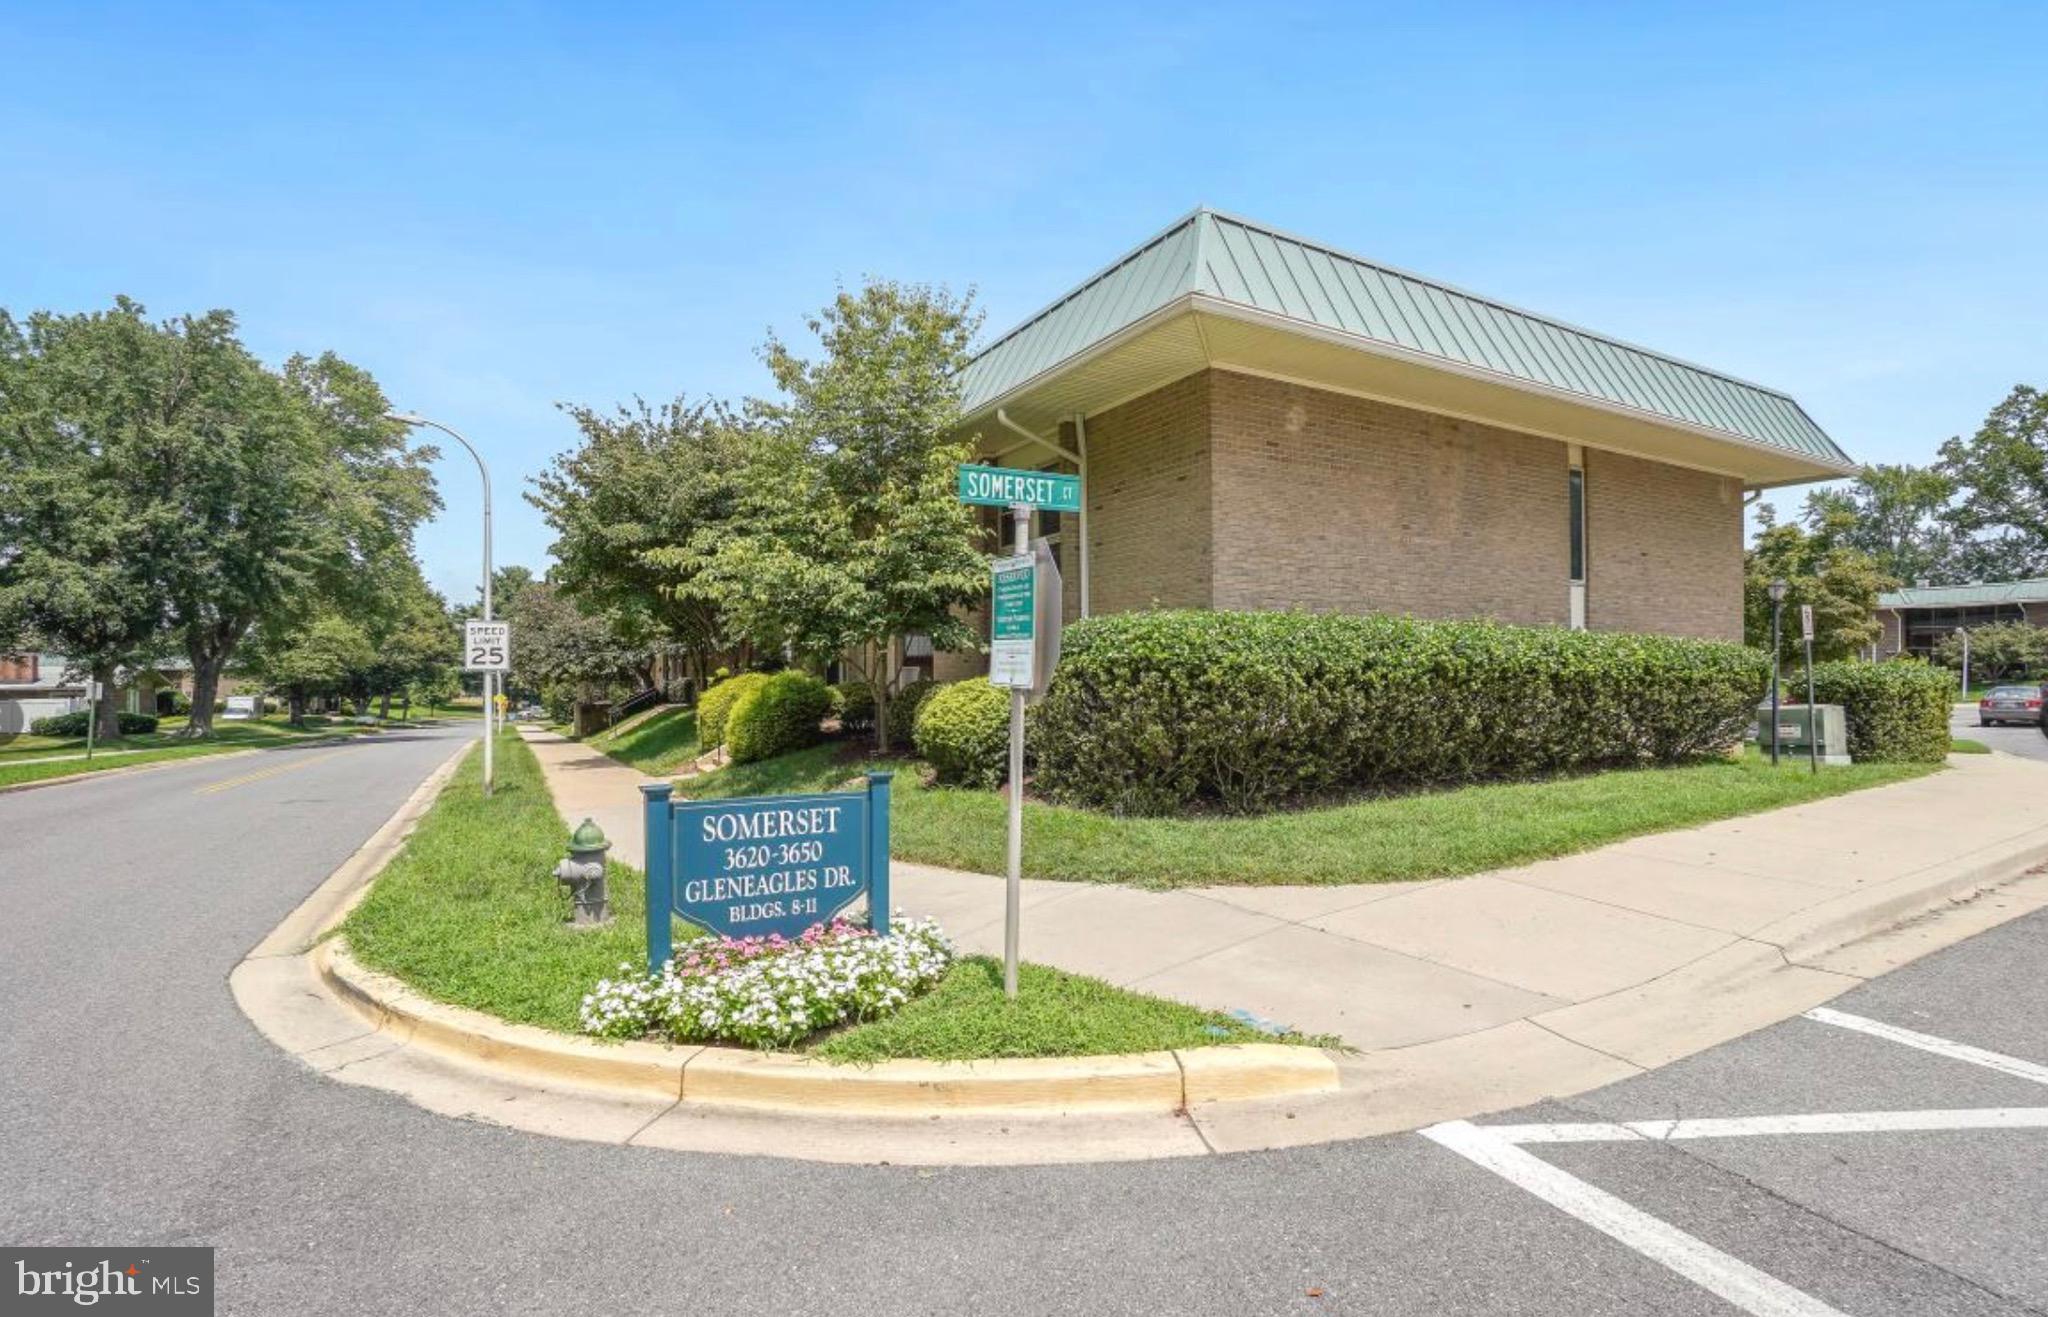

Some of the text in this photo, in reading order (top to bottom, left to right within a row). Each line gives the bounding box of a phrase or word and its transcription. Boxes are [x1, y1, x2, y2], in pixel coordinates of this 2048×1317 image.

[967, 471, 1056, 504] SOMERSET
[470, 626, 505, 636] SPEED
[473, 637, 502, 645] LIMIT
[471, 647, 504, 665] 25
[703, 807, 841, 842] SOMERSET
[723, 841, 823, 870] 3620-3650
[685, 866, 856, 903] GLENEAGLES DR.
[729, 898, 818, 923] BLDGS. 8-11
